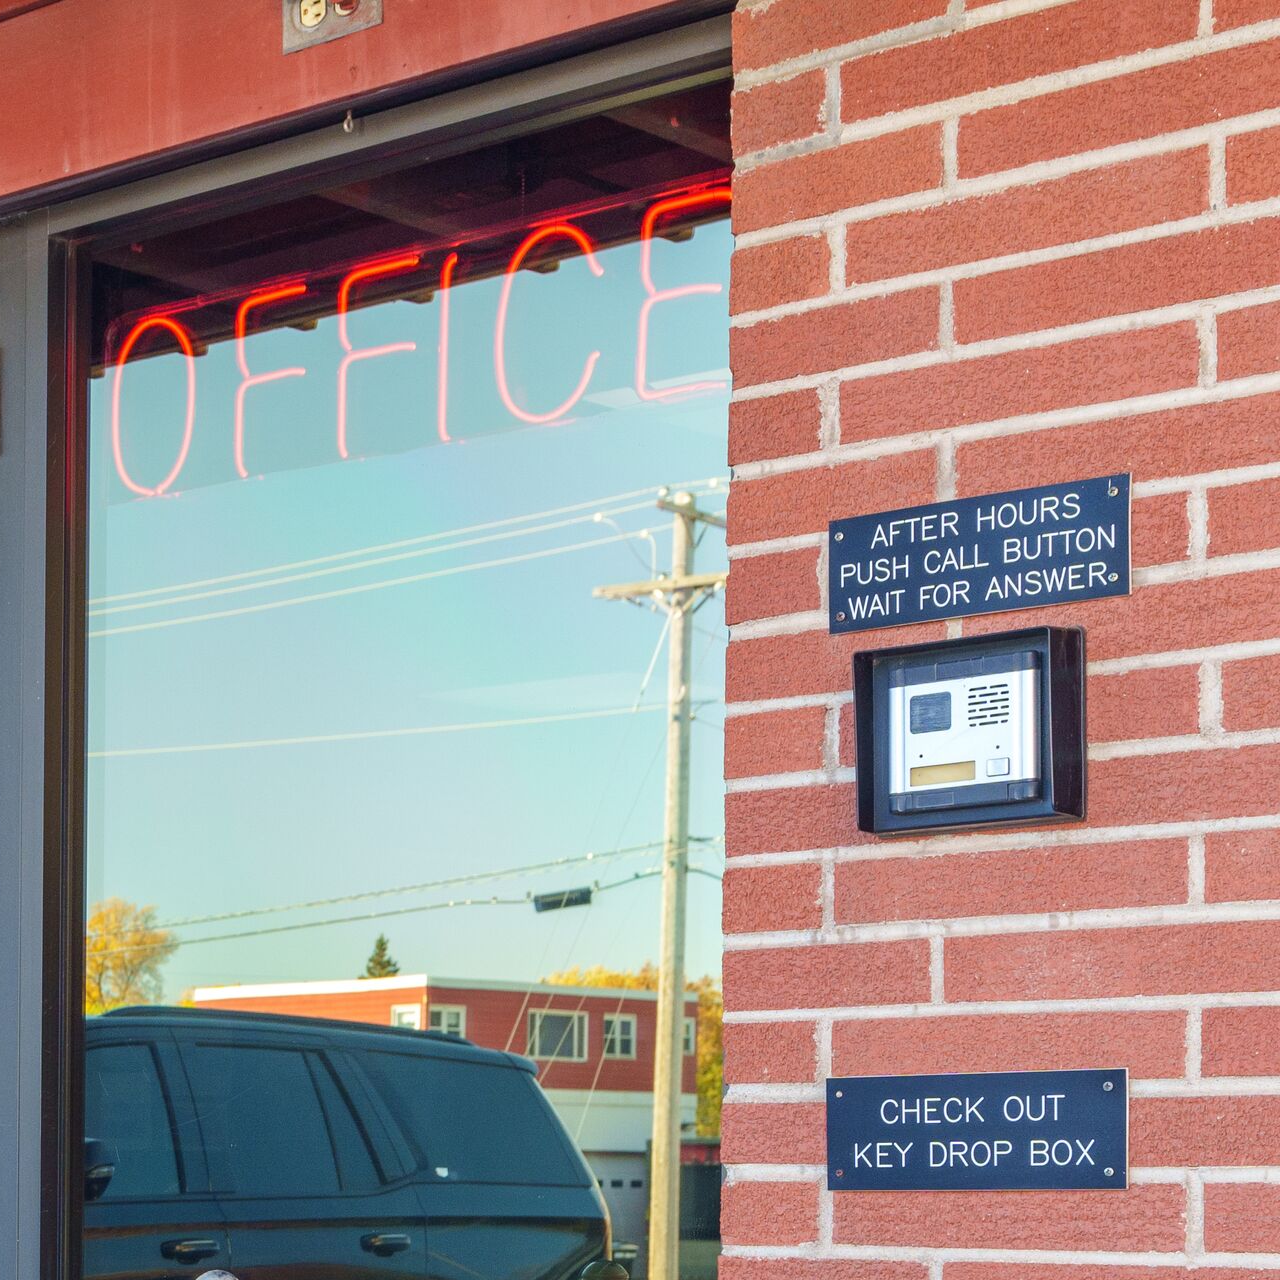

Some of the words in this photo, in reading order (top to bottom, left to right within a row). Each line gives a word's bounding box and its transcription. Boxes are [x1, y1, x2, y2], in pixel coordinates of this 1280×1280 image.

[112, 187, 732, 497] OFFICE
[870, 511, 959, 550] AFTER
[976, 493, 1081, 532] HOURS
[840, 555, 909, 588] PUSH
[924, 543, 989, 574] CALL
[1003, 524, 1116, 563] BUTTON
[848, 589, 905, 621] WAIT
[919, 581, 970, 610] FOR
[985, 562, 1108, 601] ANSWER
[880, 1096, 985, 1124] CHECK
[1003, 1094, 1066, 1122] OUT
[854, 1142, 914, 1168] KEY
[929, 1140, 1013, 1167] DROP
[1030, 1139, 1095, 1167] BOX
